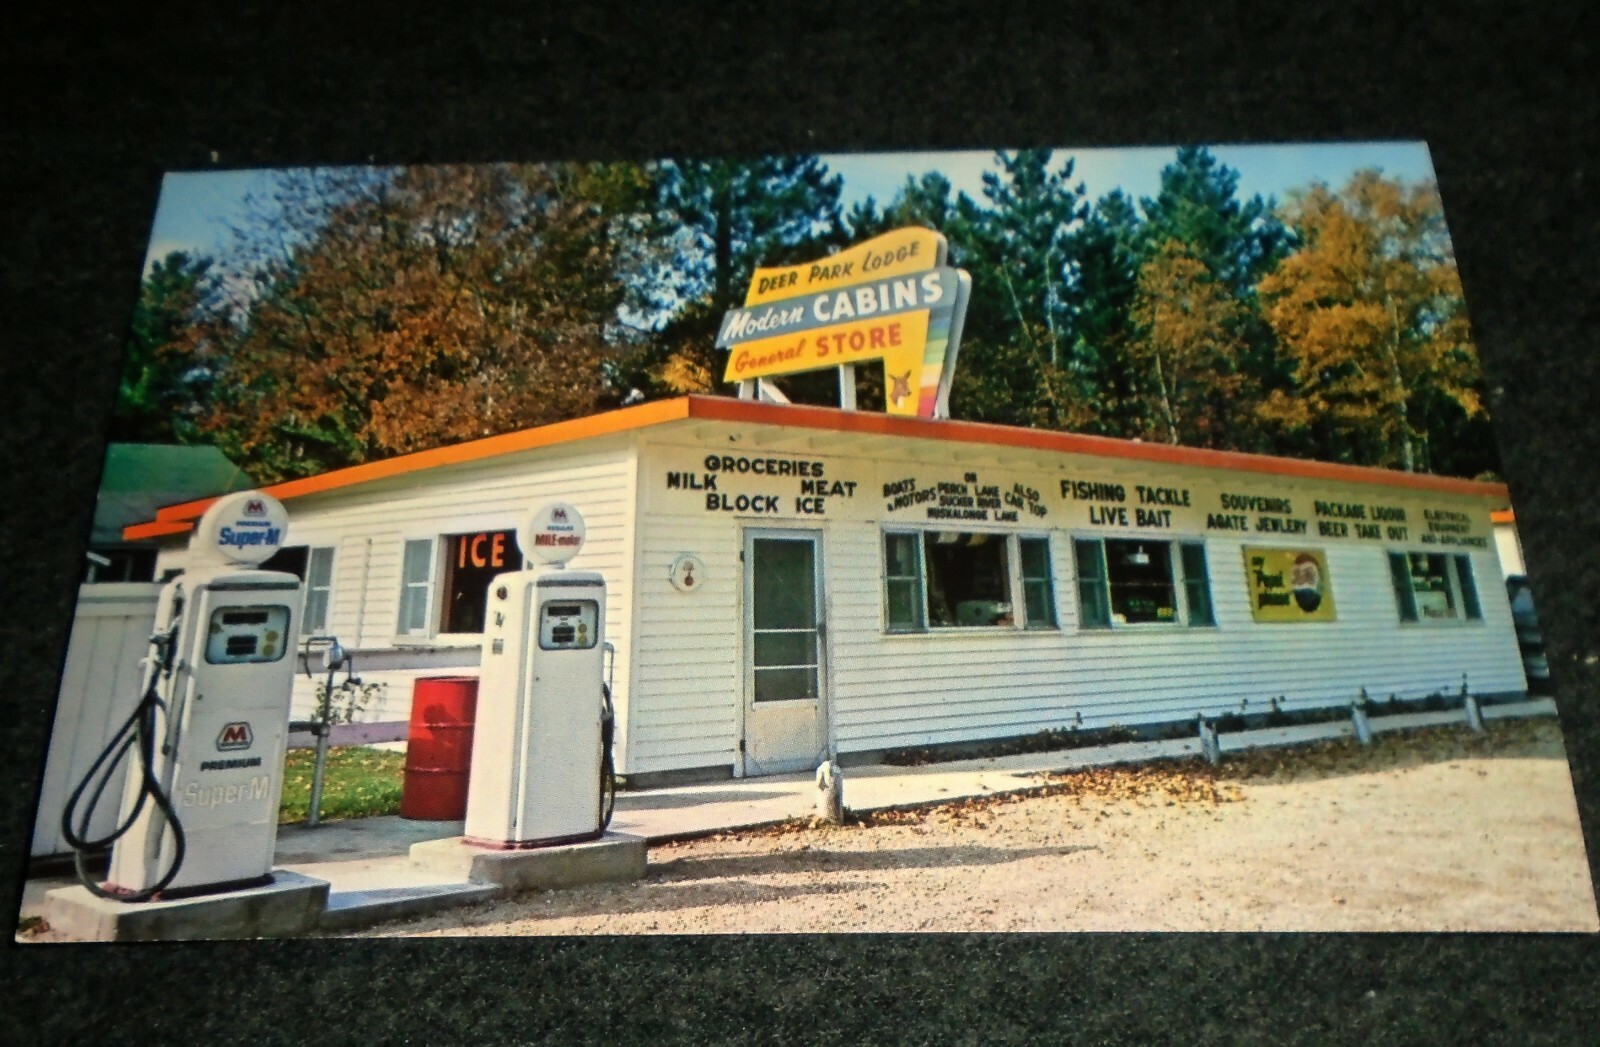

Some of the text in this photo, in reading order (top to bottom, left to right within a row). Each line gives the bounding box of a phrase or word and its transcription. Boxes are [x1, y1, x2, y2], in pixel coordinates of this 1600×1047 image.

[758, 241, 920, 295] DEER PARK LODGE
[723, 272, 943, 341] Modern CABINS
[735, 323, 902, 373] General STORE
[704, 455, 824, 477] GROCERIES
[666, 471, 857, 497] MILK MEAT
[883, 478, 916, 498] BOATS
[975, 486, 999, 497] LAKE
[1014, 483, 1040, 502] ALSO
[1060, 479, 1191, 507] FISHING TACKLE
[706, 493, 825, 514] BLOCK ICE
[894, 487, 937, 509] MOTORS
[1220, 493, 1292, 514] SOUVENIRS
[994, 510, 1019, 522] LAKE
[1089, 506, 1172, 528] LIVE BAIT
[1207, 513, 1249, 532] AGATE
[1318, 521, 1408, 541] BEER TAKE OUT
[459, 533, 505, 568] ICE
[223, 726, 247, 742] M
[201, 757, 262, 772] PREMIUM
